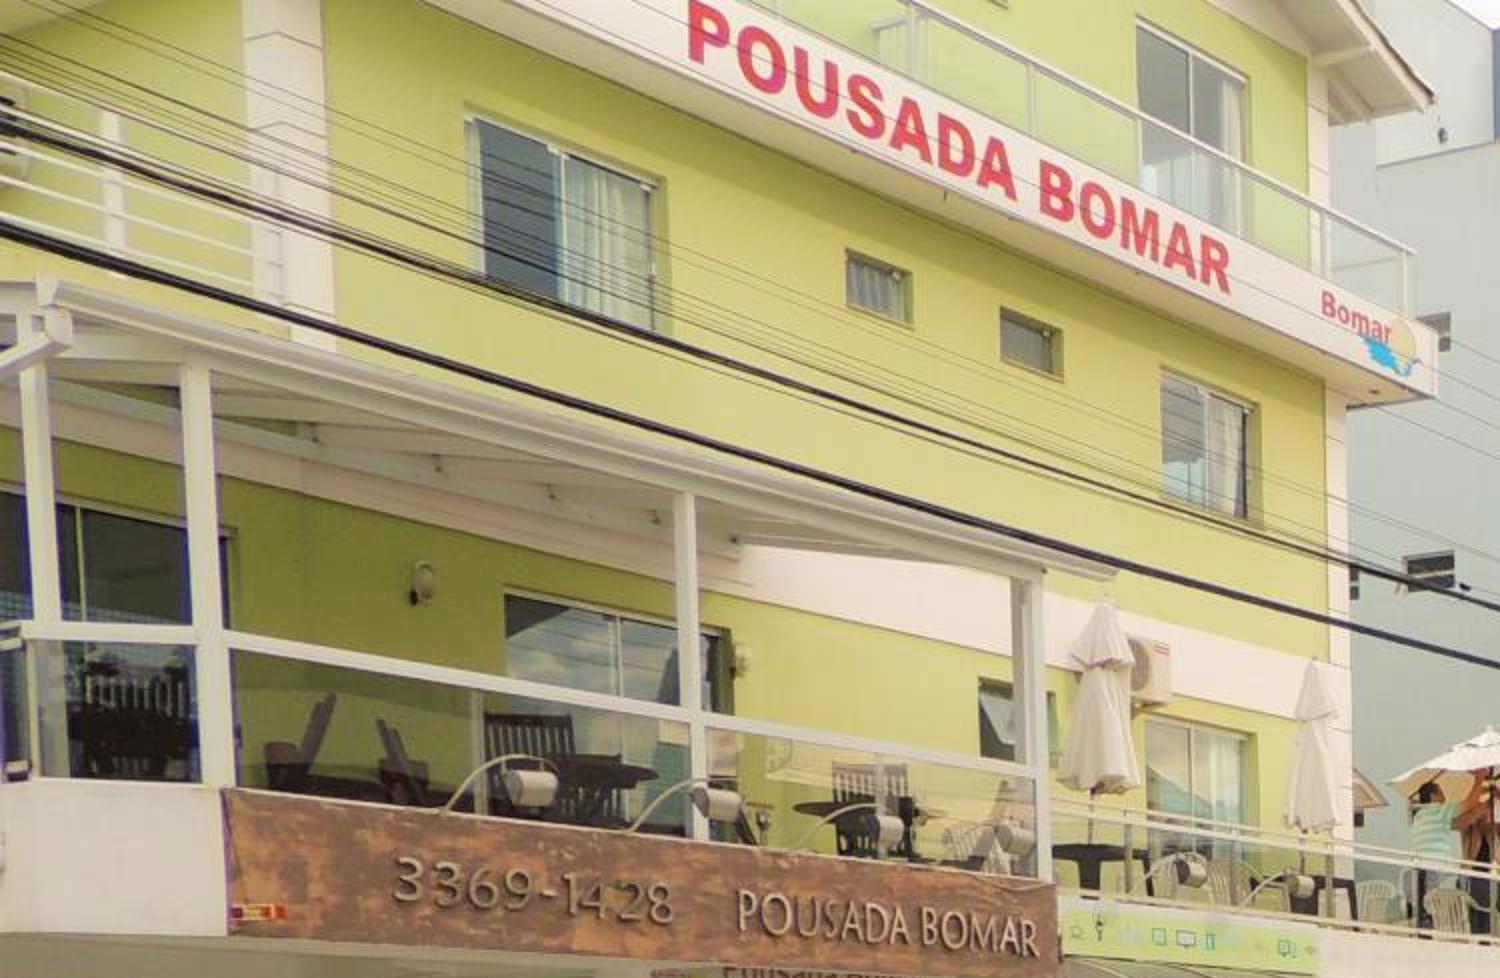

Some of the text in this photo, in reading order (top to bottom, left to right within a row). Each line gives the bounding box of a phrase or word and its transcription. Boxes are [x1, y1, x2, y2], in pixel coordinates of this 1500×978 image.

[688, 0, 1232, 295] POUSADA BOMAR
[1321, 289, 1393, 344] Bomar
[393, 855, 673, 925] 3369-1428
[738, 889, 1040, 958] POUSADA BOMAR
